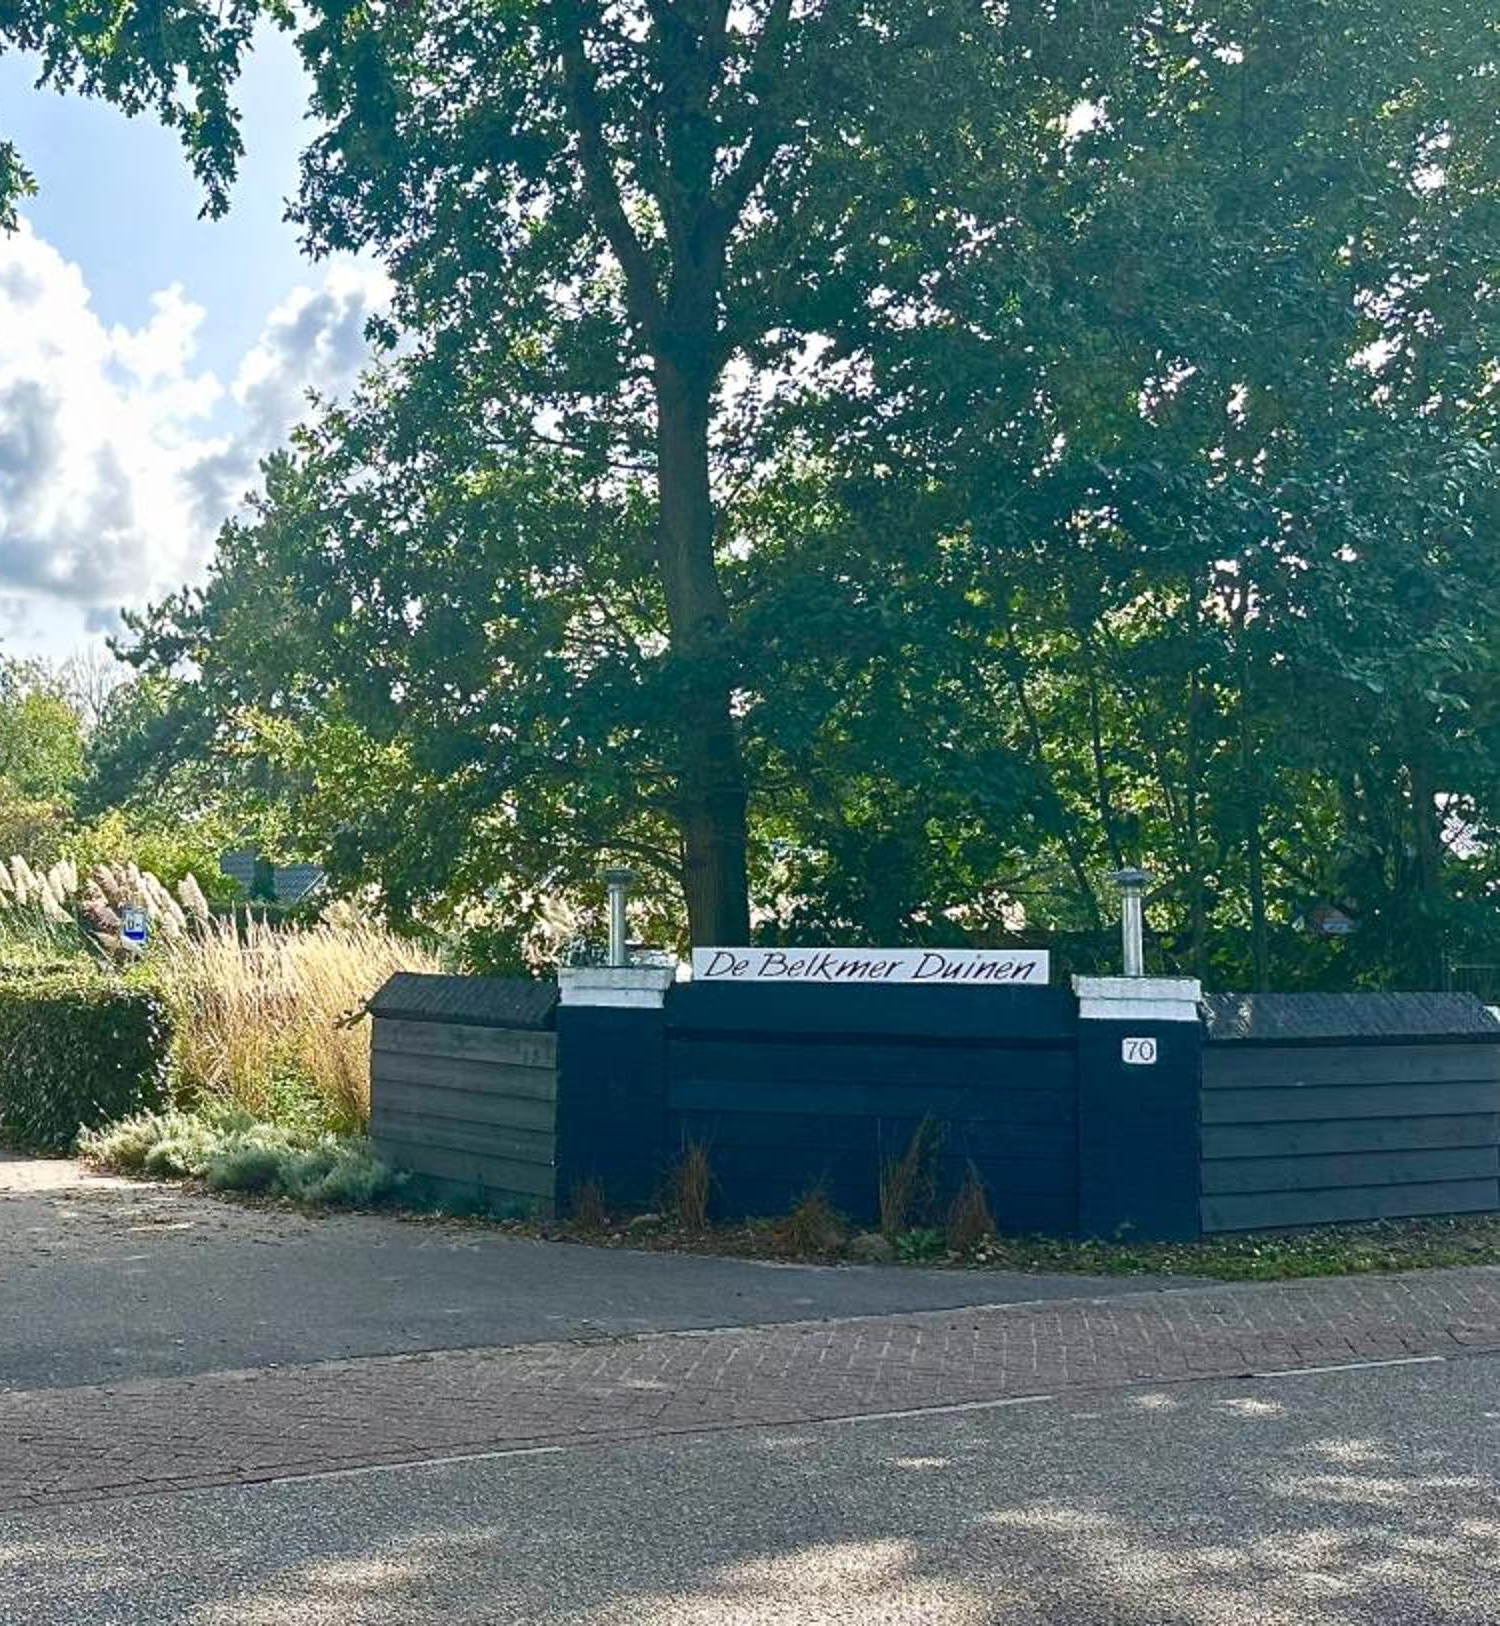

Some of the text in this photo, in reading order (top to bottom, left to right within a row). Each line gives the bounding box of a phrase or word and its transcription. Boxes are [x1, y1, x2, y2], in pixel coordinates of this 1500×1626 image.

[703, 951, 1038, 981] De Belkmer Duinen
[1125, 1039, 1155, 1061] 70
